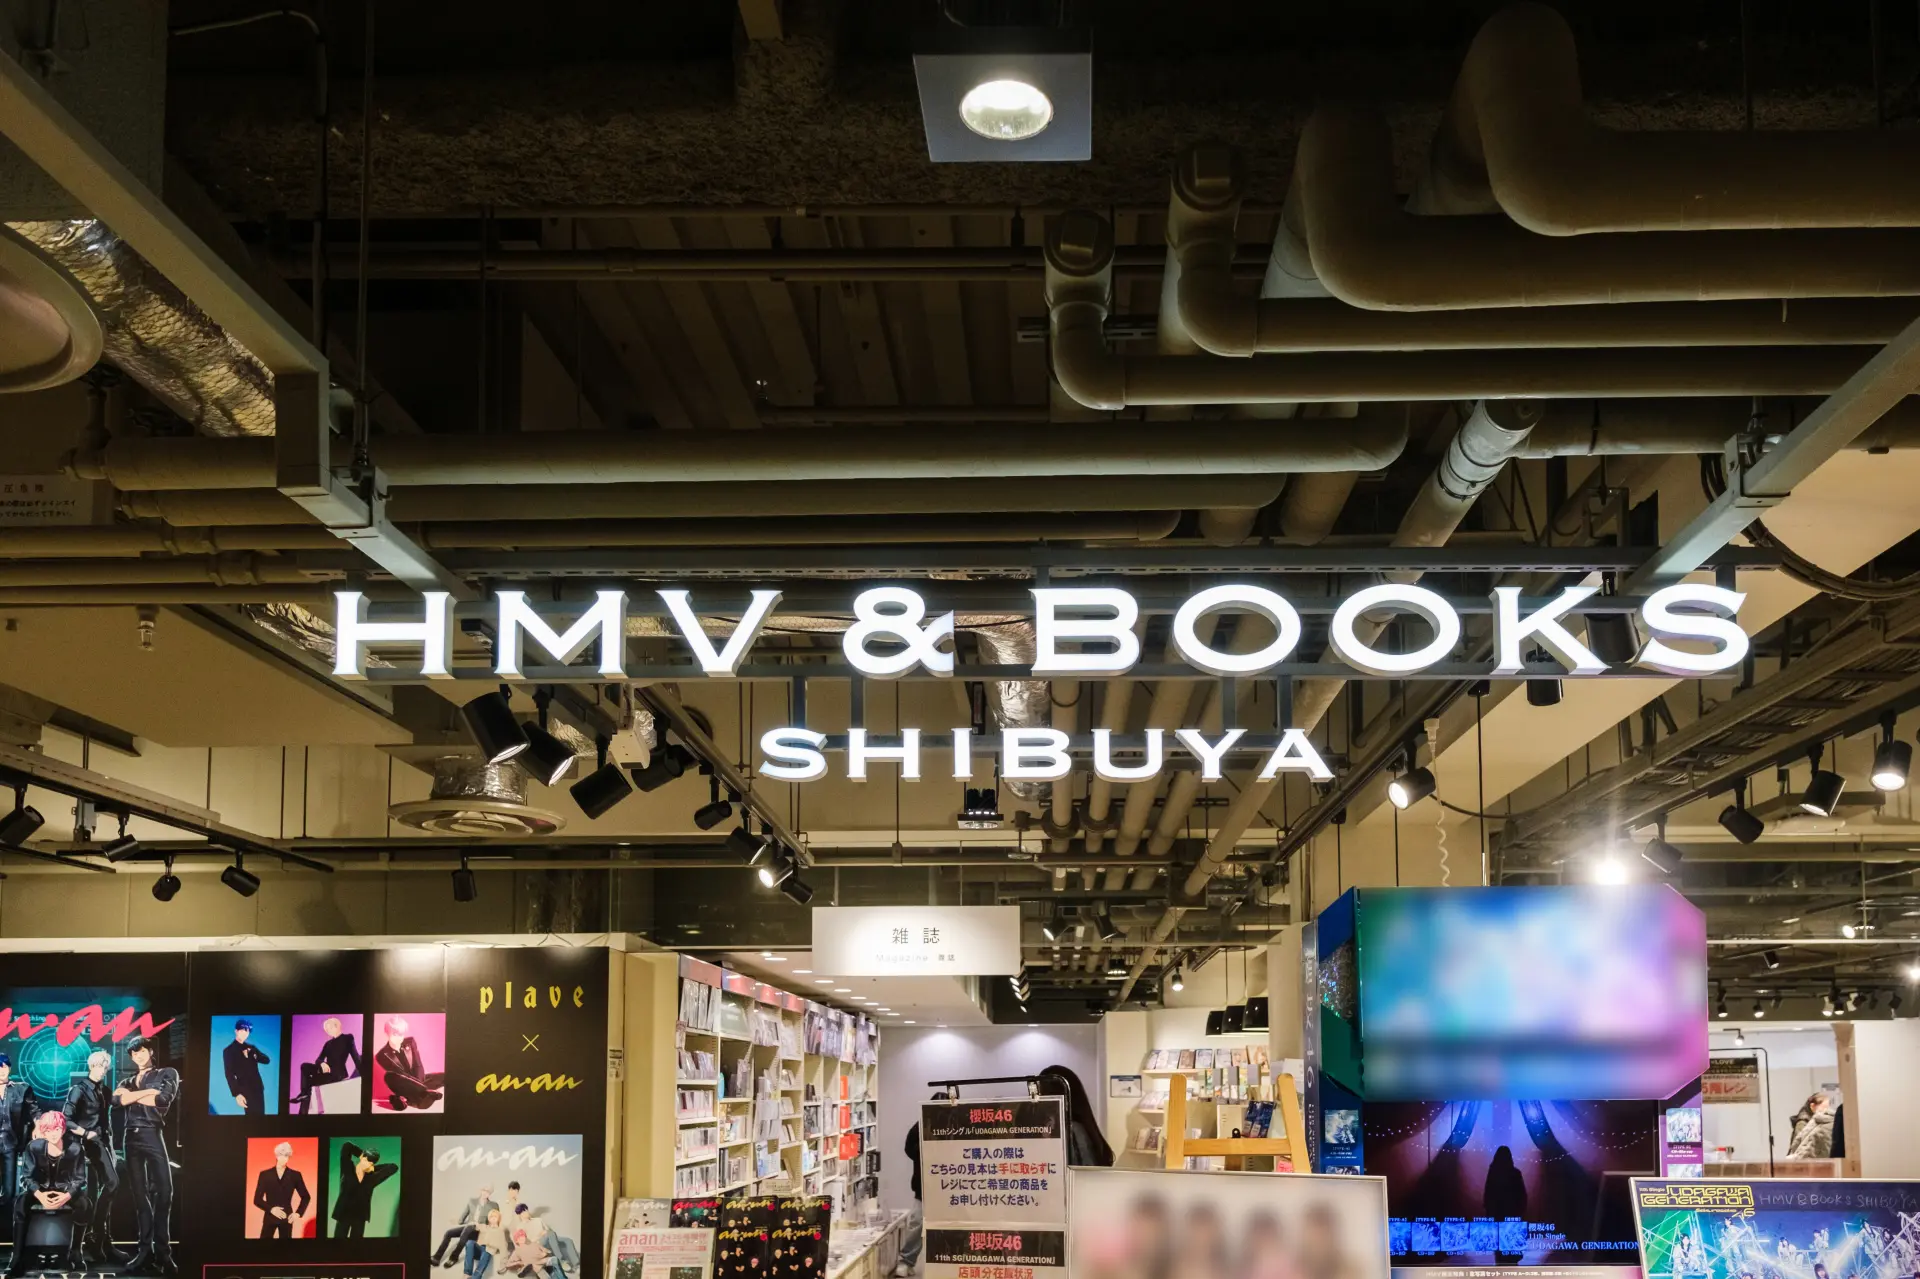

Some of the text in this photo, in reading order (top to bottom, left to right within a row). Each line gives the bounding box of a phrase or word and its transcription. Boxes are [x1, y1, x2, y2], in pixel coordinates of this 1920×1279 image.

[332, 583, 1750, 680] HMV & BOOKS
[760, 727, 1336, 783] SHIBUYA
[479, 981, 585, 1014] plave
[969, 1109, 1013, 1123] 櫻坂46
[962, 1147, 1025, 1160] ご購入の際は
[930, 1163, 1057, 1175] こちらの見本は手に取らずに
[940, 1178, 1048, 1191] レジにてご希望の商品を
[949, 1194, 1040, 1207] お申し付けください。
[969, 1233, 1022, 1250] 櫻坂46
[1545, 1233, 1566, 1241] Single
[957, 1266, 1035, 1279] 店頭分在庫状況
